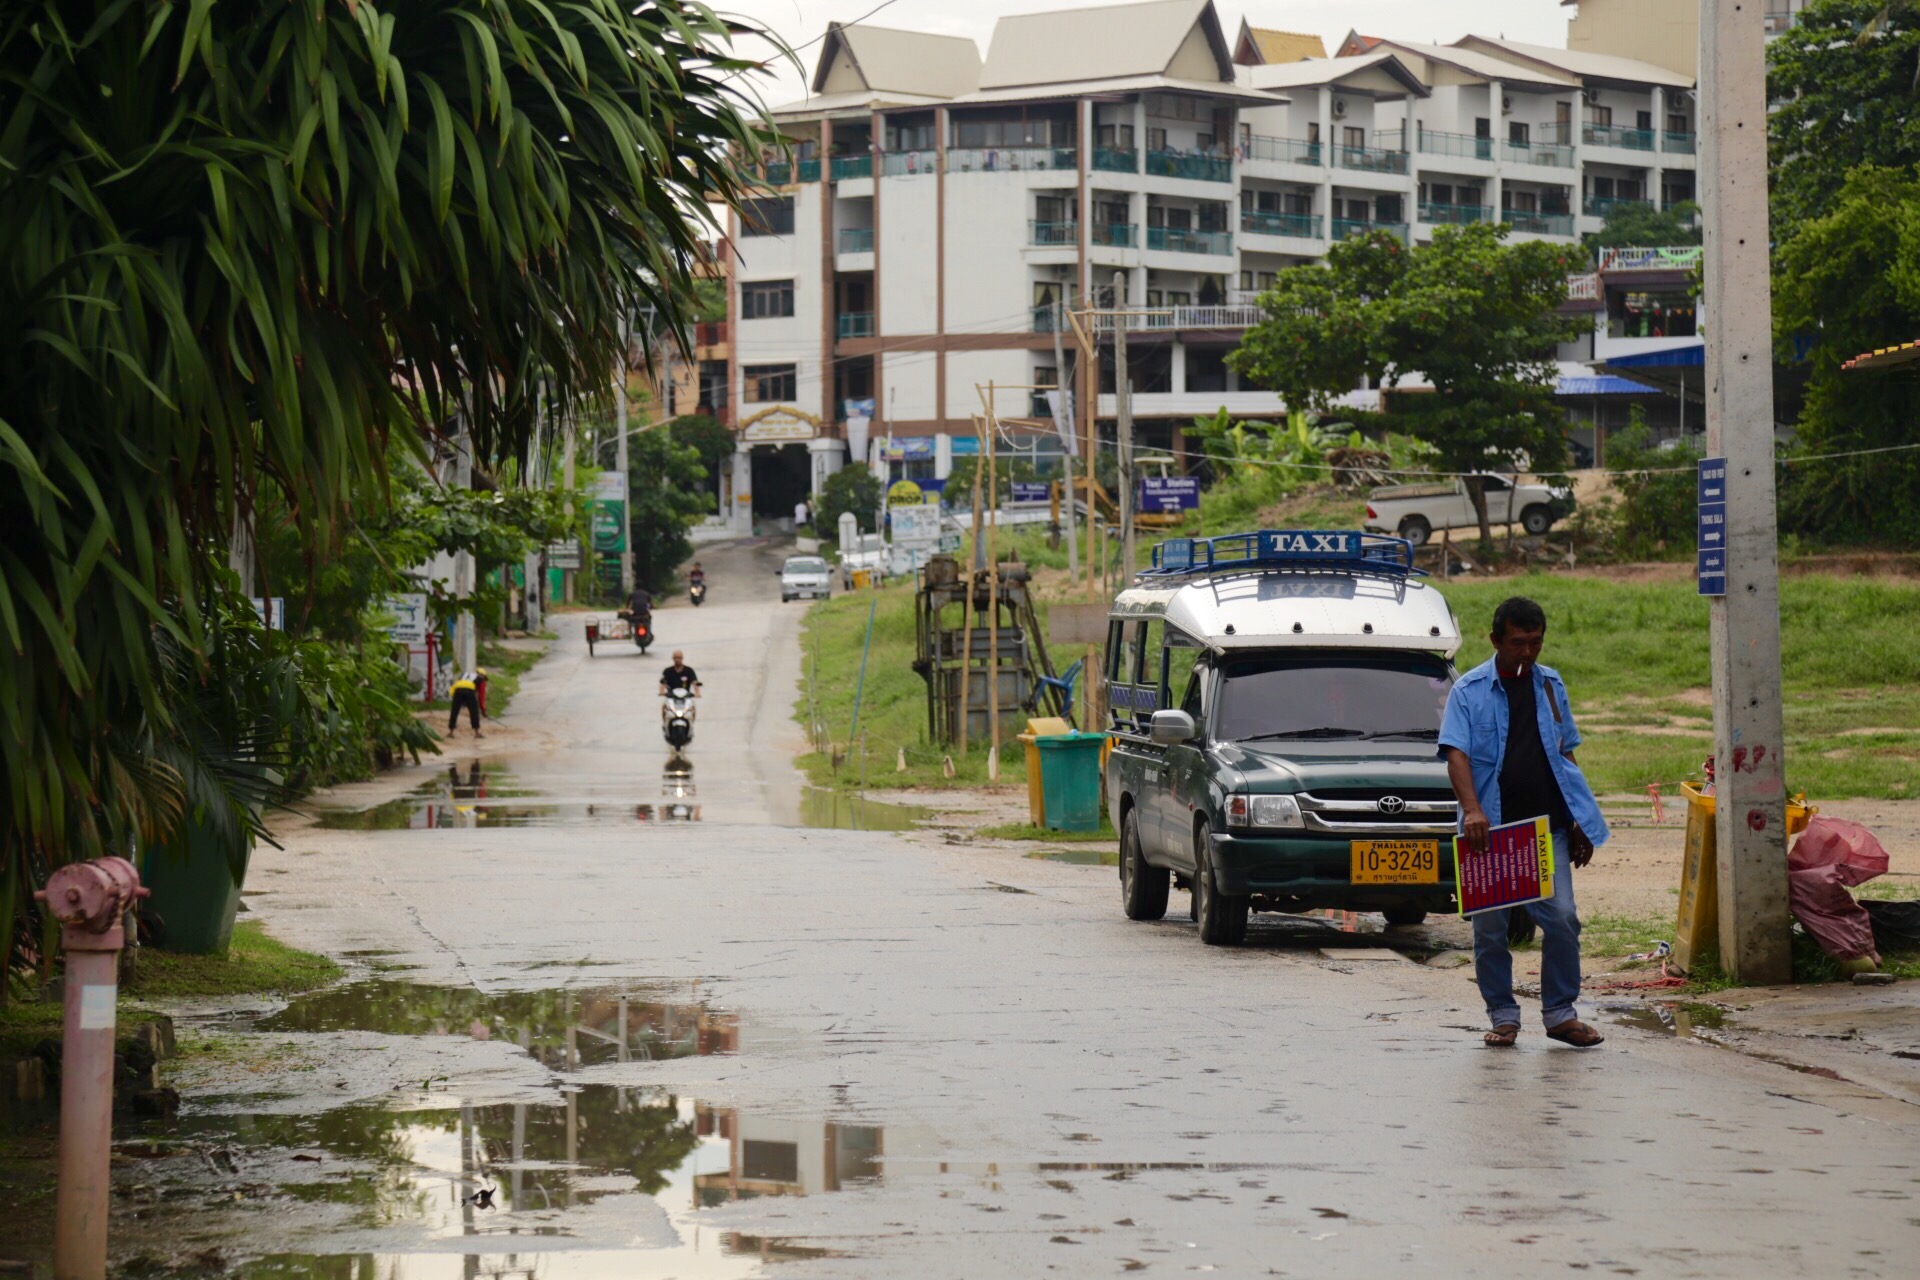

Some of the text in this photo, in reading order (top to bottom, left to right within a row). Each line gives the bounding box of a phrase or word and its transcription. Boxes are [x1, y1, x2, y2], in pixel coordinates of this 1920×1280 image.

[1166, 479, 1195, 488] Station
[1270, 534, 1349, 552] TAXI
[1538, 833, 1547, 857] TAXI
[1360, 850, 1434, 870] 10-3249
